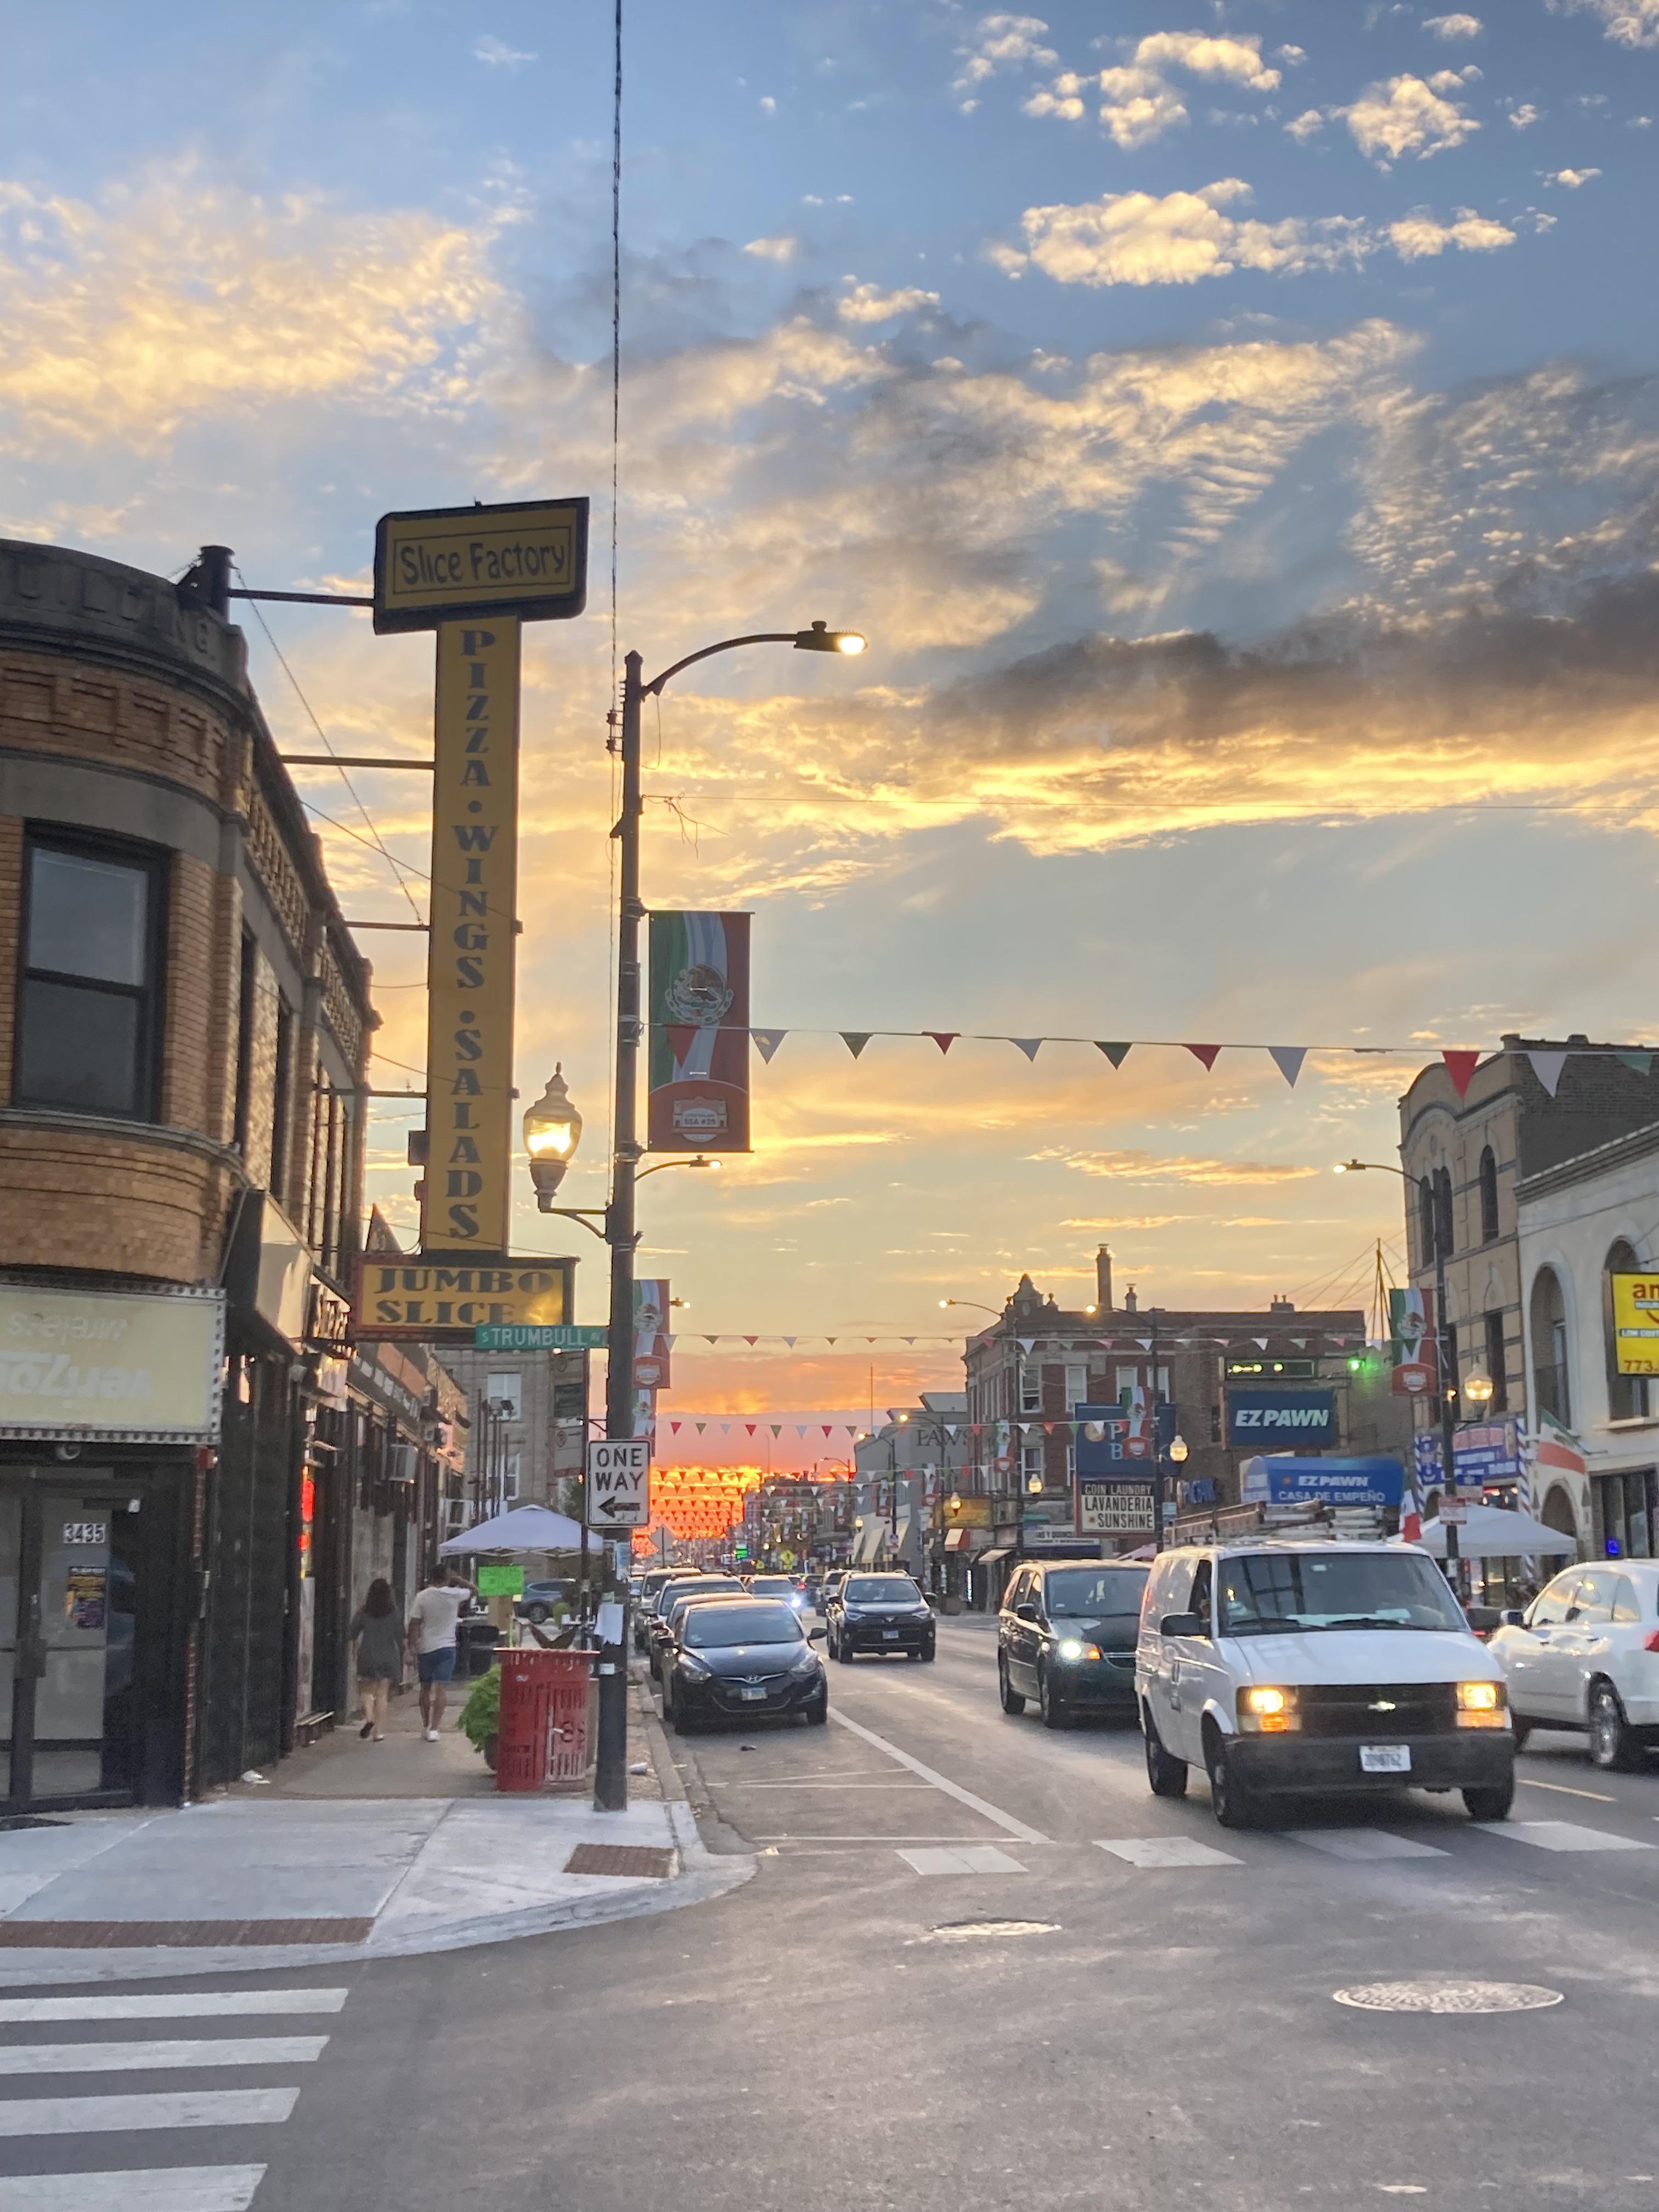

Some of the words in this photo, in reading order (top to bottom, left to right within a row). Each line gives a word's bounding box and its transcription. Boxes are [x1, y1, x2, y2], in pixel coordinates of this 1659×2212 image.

[400, 545, 464, 585] Slice
[469, 541, 566, 582] Factory
[458, 629, 496, 787] PIZZA
[450, 825, 499, 989] WINGS
[445, 1029, 484, 1239] SALADS
[374, 1267, 554, 1294] JUMBO
[376, 1301, 514, 1324] SLICE
[481, 1331, 489, 1343] S
[491, 1328, 588, 1346] TRUMBULL
[596, 1448, 642, 1468] ONE
[595, 1471, 644, 1491] WAY
[1085, 1483, 1107, 1495] COIN
[1111, 1484, 1152, 1496] LAUNDRY
[1085, 1497, 1153, 1512] LAVANDERIA
[1279, 1491, 1311, 1502] CASA
[1316, 1492, 1331, 1502] DE
[1335, 1489, 1386, 1502] EMPEÑO
[1098, 1513, 1153, 1528] SUNSHINE
[66, 1523, 104, 1542] 3435
